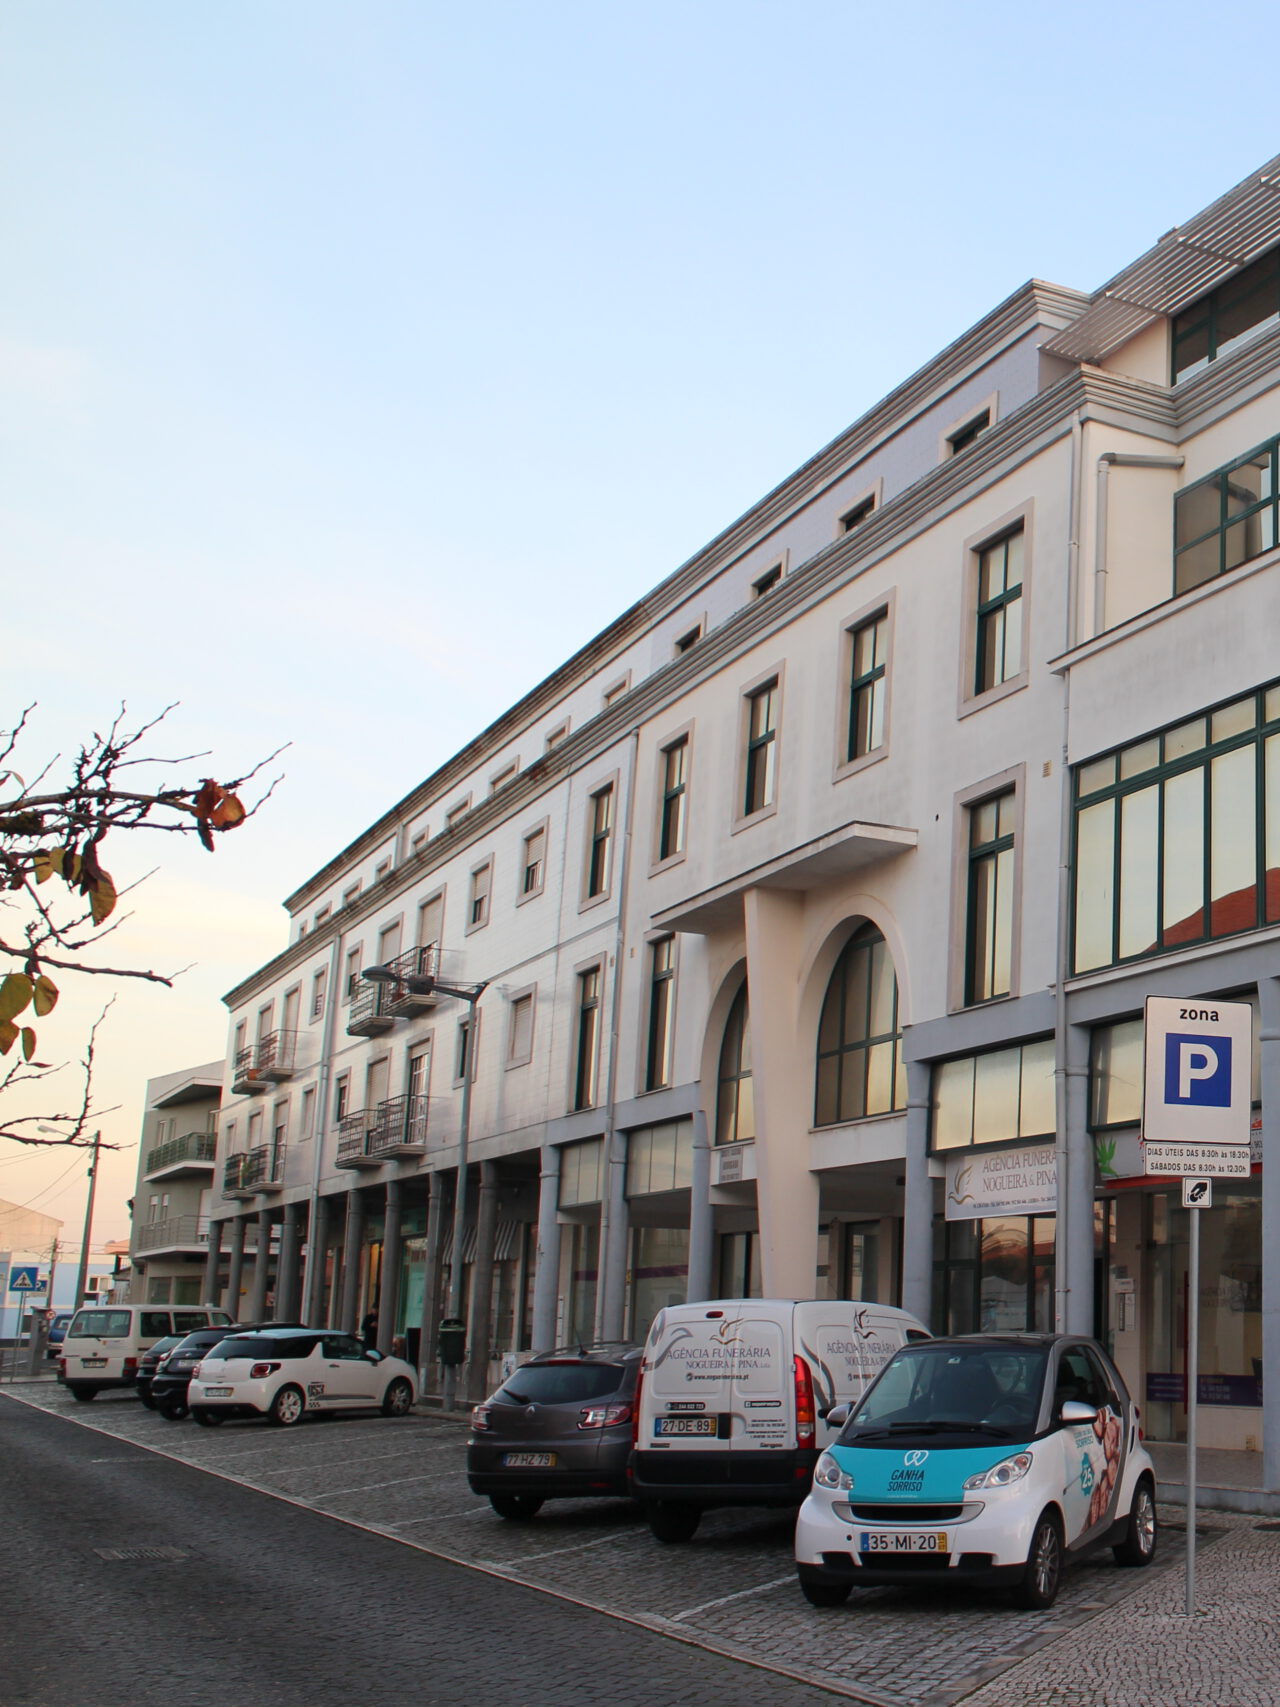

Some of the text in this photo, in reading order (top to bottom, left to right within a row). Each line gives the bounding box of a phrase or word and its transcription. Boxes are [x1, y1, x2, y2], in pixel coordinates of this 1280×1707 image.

[1179, 1008, 1219, 1022] zona
[1179, 1042, 1219, 1098] P
[1147, 1147, 1163, 1156] DIAS
[1186, 1149, 1199, 1158] DAS
[982, 1155, 1021, 1174] AGÊNCIA
[1183, 1163, 1196, 1172] DAS
[982, 1174, 1028, 1193] NOGUEIRA
[1029, 1174, 1035, 1186] &
[666, 1345, 771, 1360] AGÊNCIA FUNERÁRIA
[686, 1360, 730, 1369] NOGUEIRA
[738, 1359, 758, 1369] PINA
[891, 1469, 925, 1481] GANHA
[1082, 1468, 1093, 1488] 25
[887, 1481, 923, 1492] SORRISO
[870, 1534, 937, 1550] 35-MI-20
